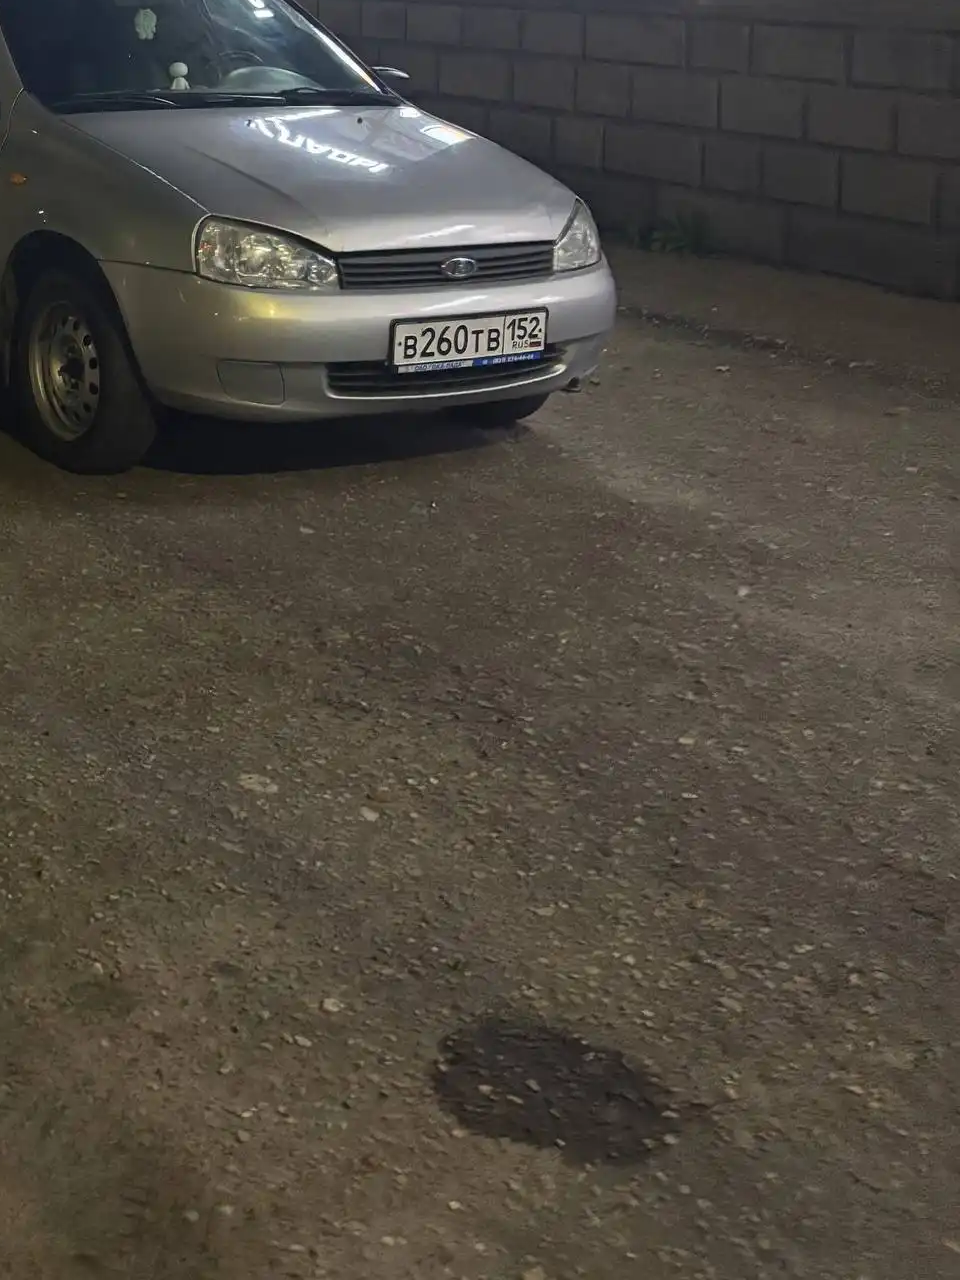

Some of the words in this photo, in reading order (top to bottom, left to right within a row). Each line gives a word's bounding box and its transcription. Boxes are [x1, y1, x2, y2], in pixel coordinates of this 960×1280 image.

[403, 324, 501, 360] В260ТВ
[506, 316, 542, 342] 152
[512, 340, 530, 350] RUS
